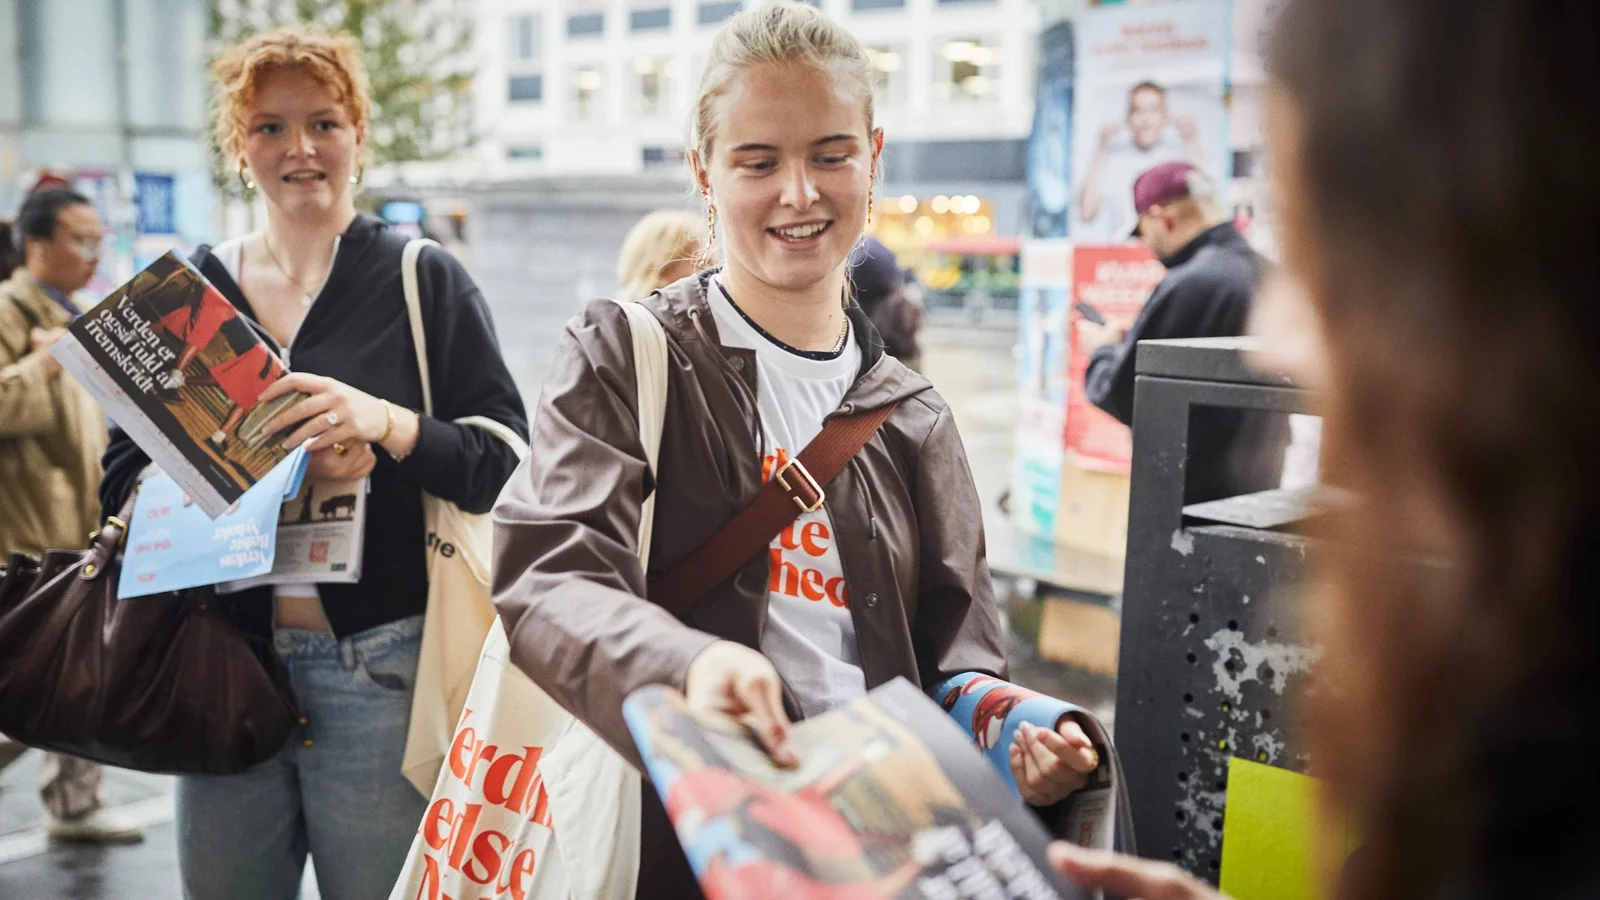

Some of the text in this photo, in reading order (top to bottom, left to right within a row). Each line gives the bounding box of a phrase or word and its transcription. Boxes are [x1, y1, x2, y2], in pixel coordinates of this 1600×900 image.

[84, 318, 155, 395] fremskridt
[100, 309, 137, 345] også
[129, 341, 164, 374] fuld
[117, 294, 176, 361] Verden er
